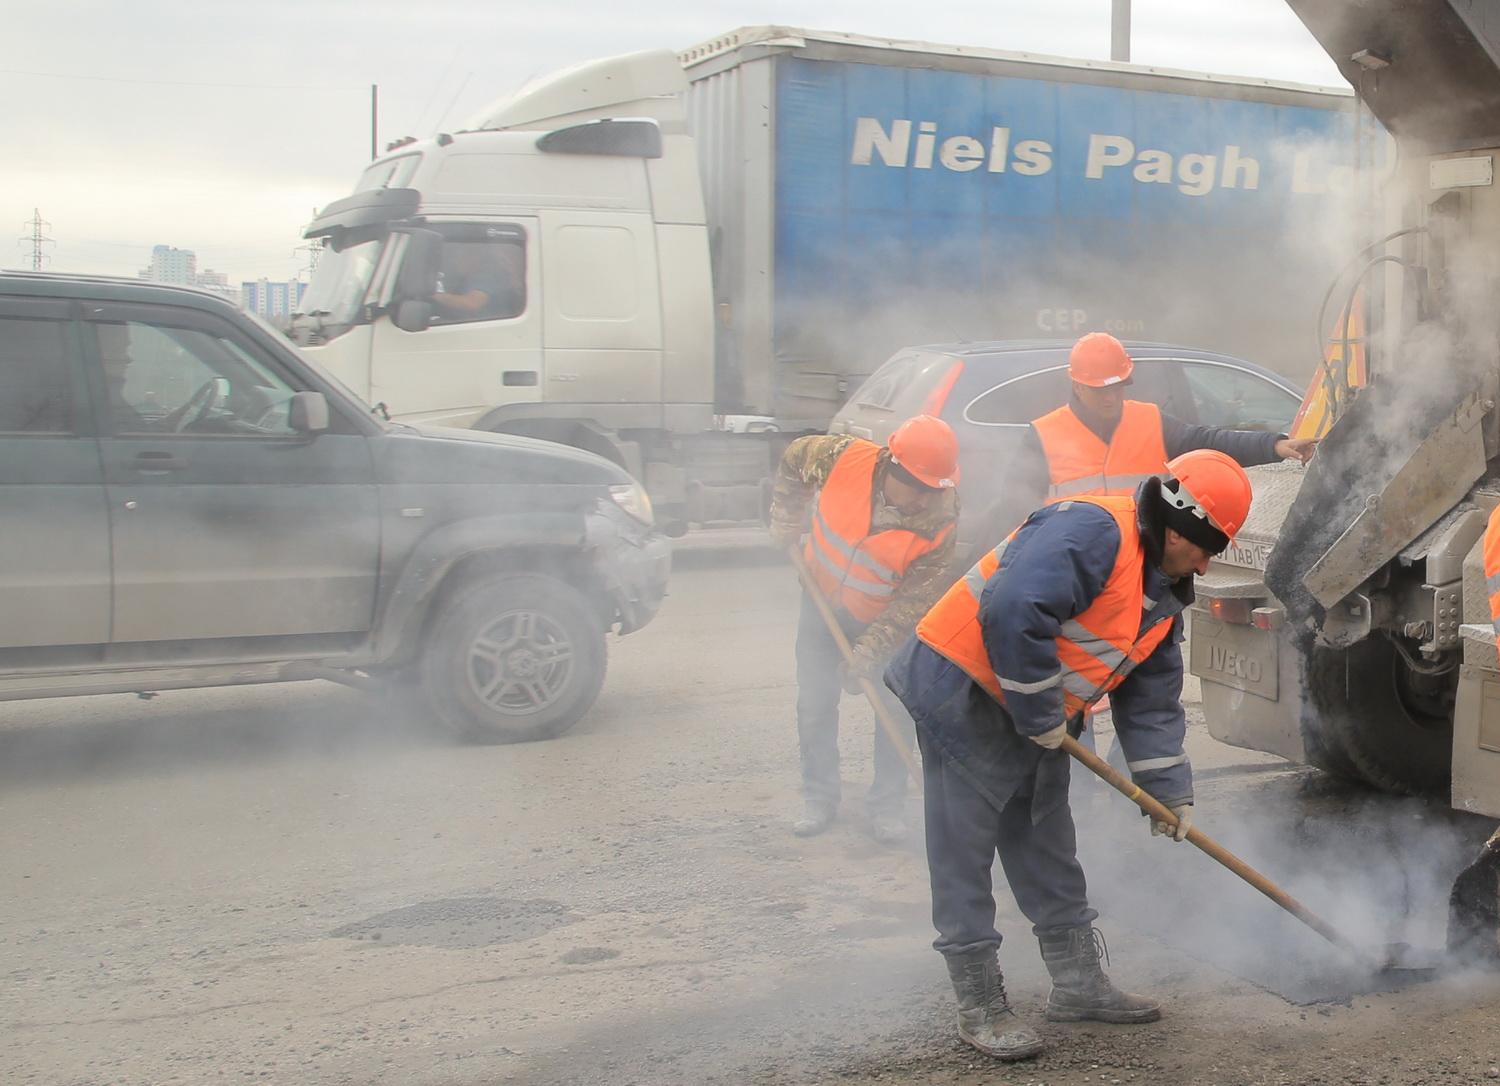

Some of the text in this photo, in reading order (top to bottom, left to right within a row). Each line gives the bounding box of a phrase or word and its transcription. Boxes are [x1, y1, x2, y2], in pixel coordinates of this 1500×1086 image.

[851, 116, 1053, 176] Niels
[1085, 133, 1260, 196] Pagh
[1208, 645, 1263, 683] IVECO
